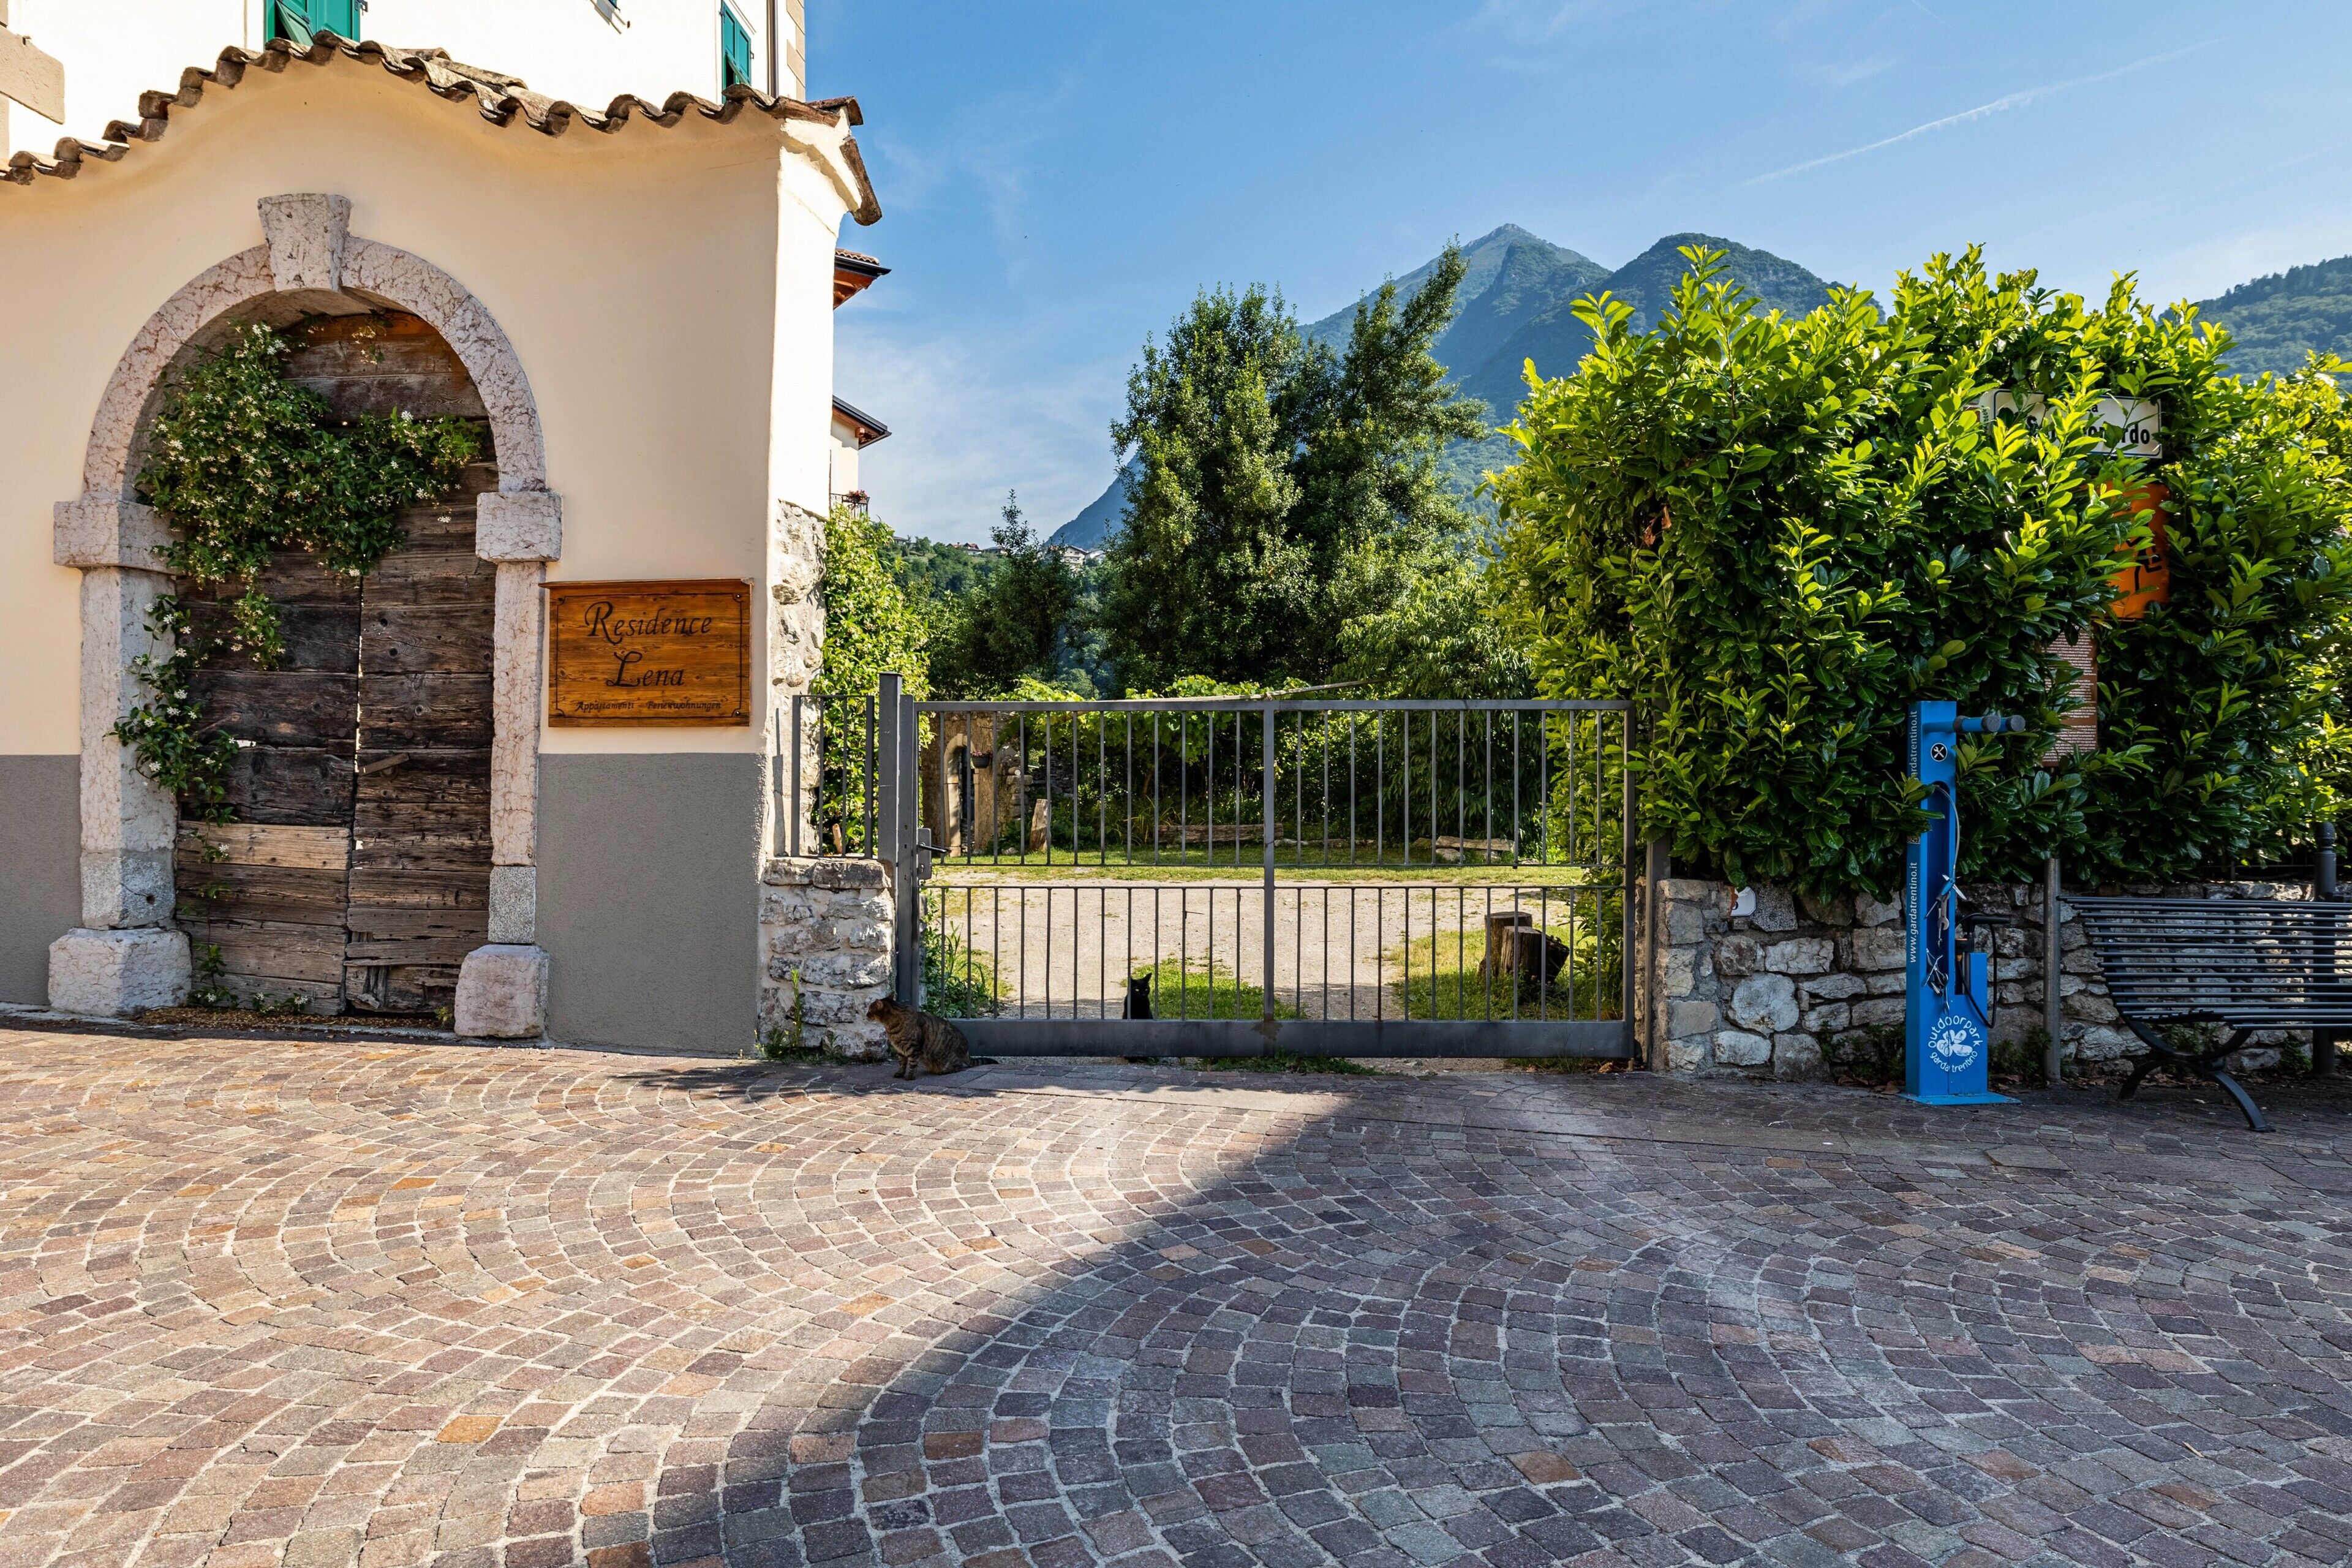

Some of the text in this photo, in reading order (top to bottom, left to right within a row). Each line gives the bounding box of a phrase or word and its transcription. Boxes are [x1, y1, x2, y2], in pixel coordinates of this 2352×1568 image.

[584, 600, 712, 646] Residence
[606, 650, 685, 687] Lena
[1909, 862, 1918, 963] www.gardatrentino.it
[1928, 1015, 1983, 1048] outdoorpark
[1929, 1050, 1978, 1072] garda trentino
